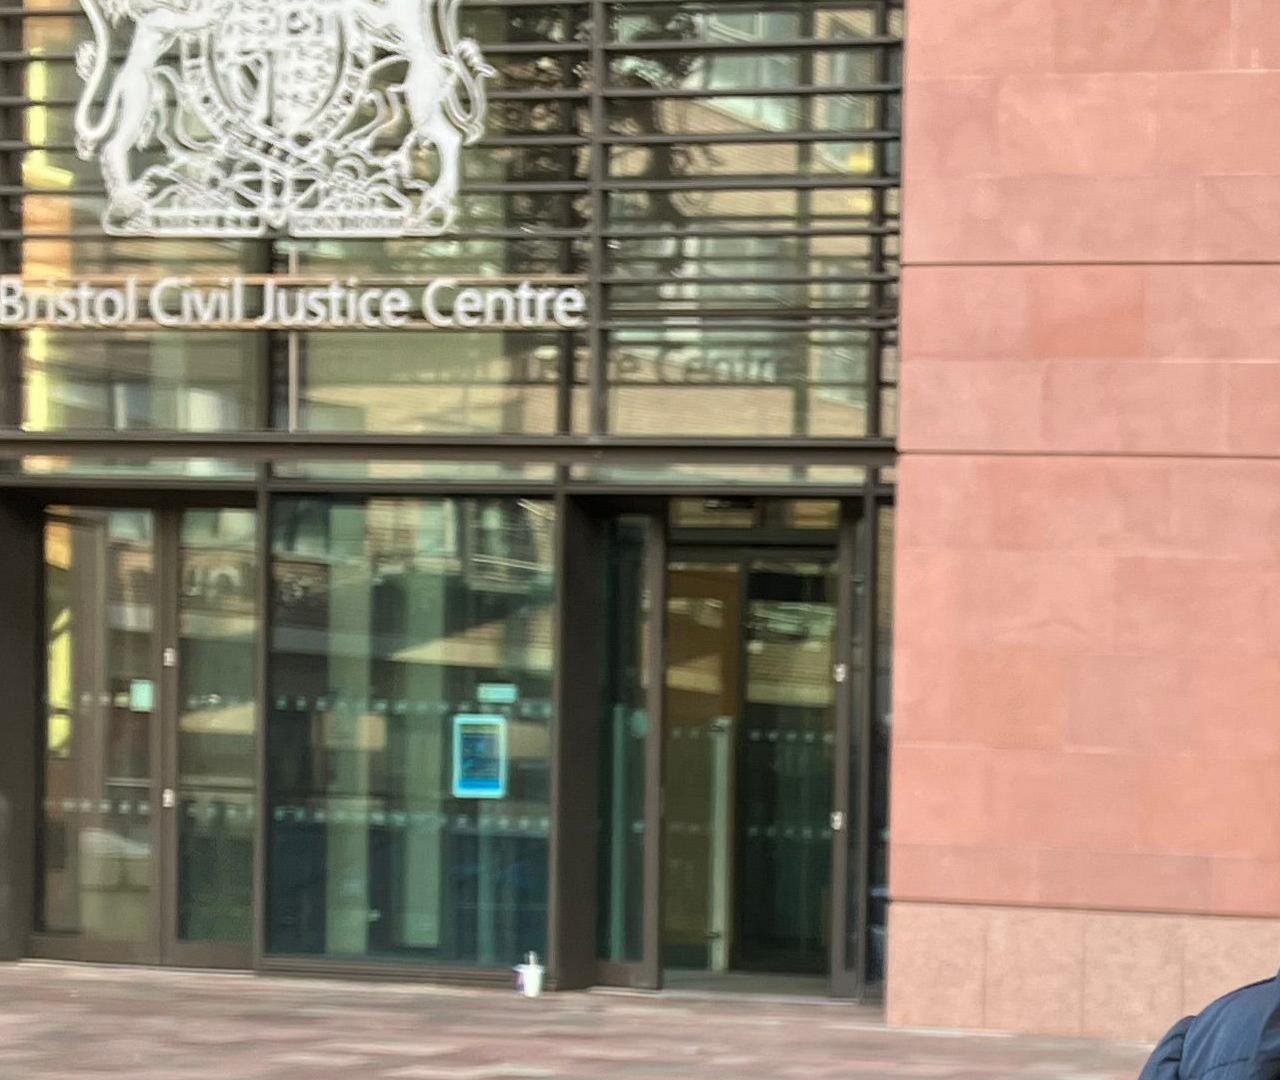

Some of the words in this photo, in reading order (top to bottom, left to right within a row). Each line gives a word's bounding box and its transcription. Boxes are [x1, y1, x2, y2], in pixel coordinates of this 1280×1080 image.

[0, 277, 136, 325] Bristol
[151, 276, 243, 326] Civil
[254, 278, 411, 327] Justice
[422, 278, 586, 328] Centre
